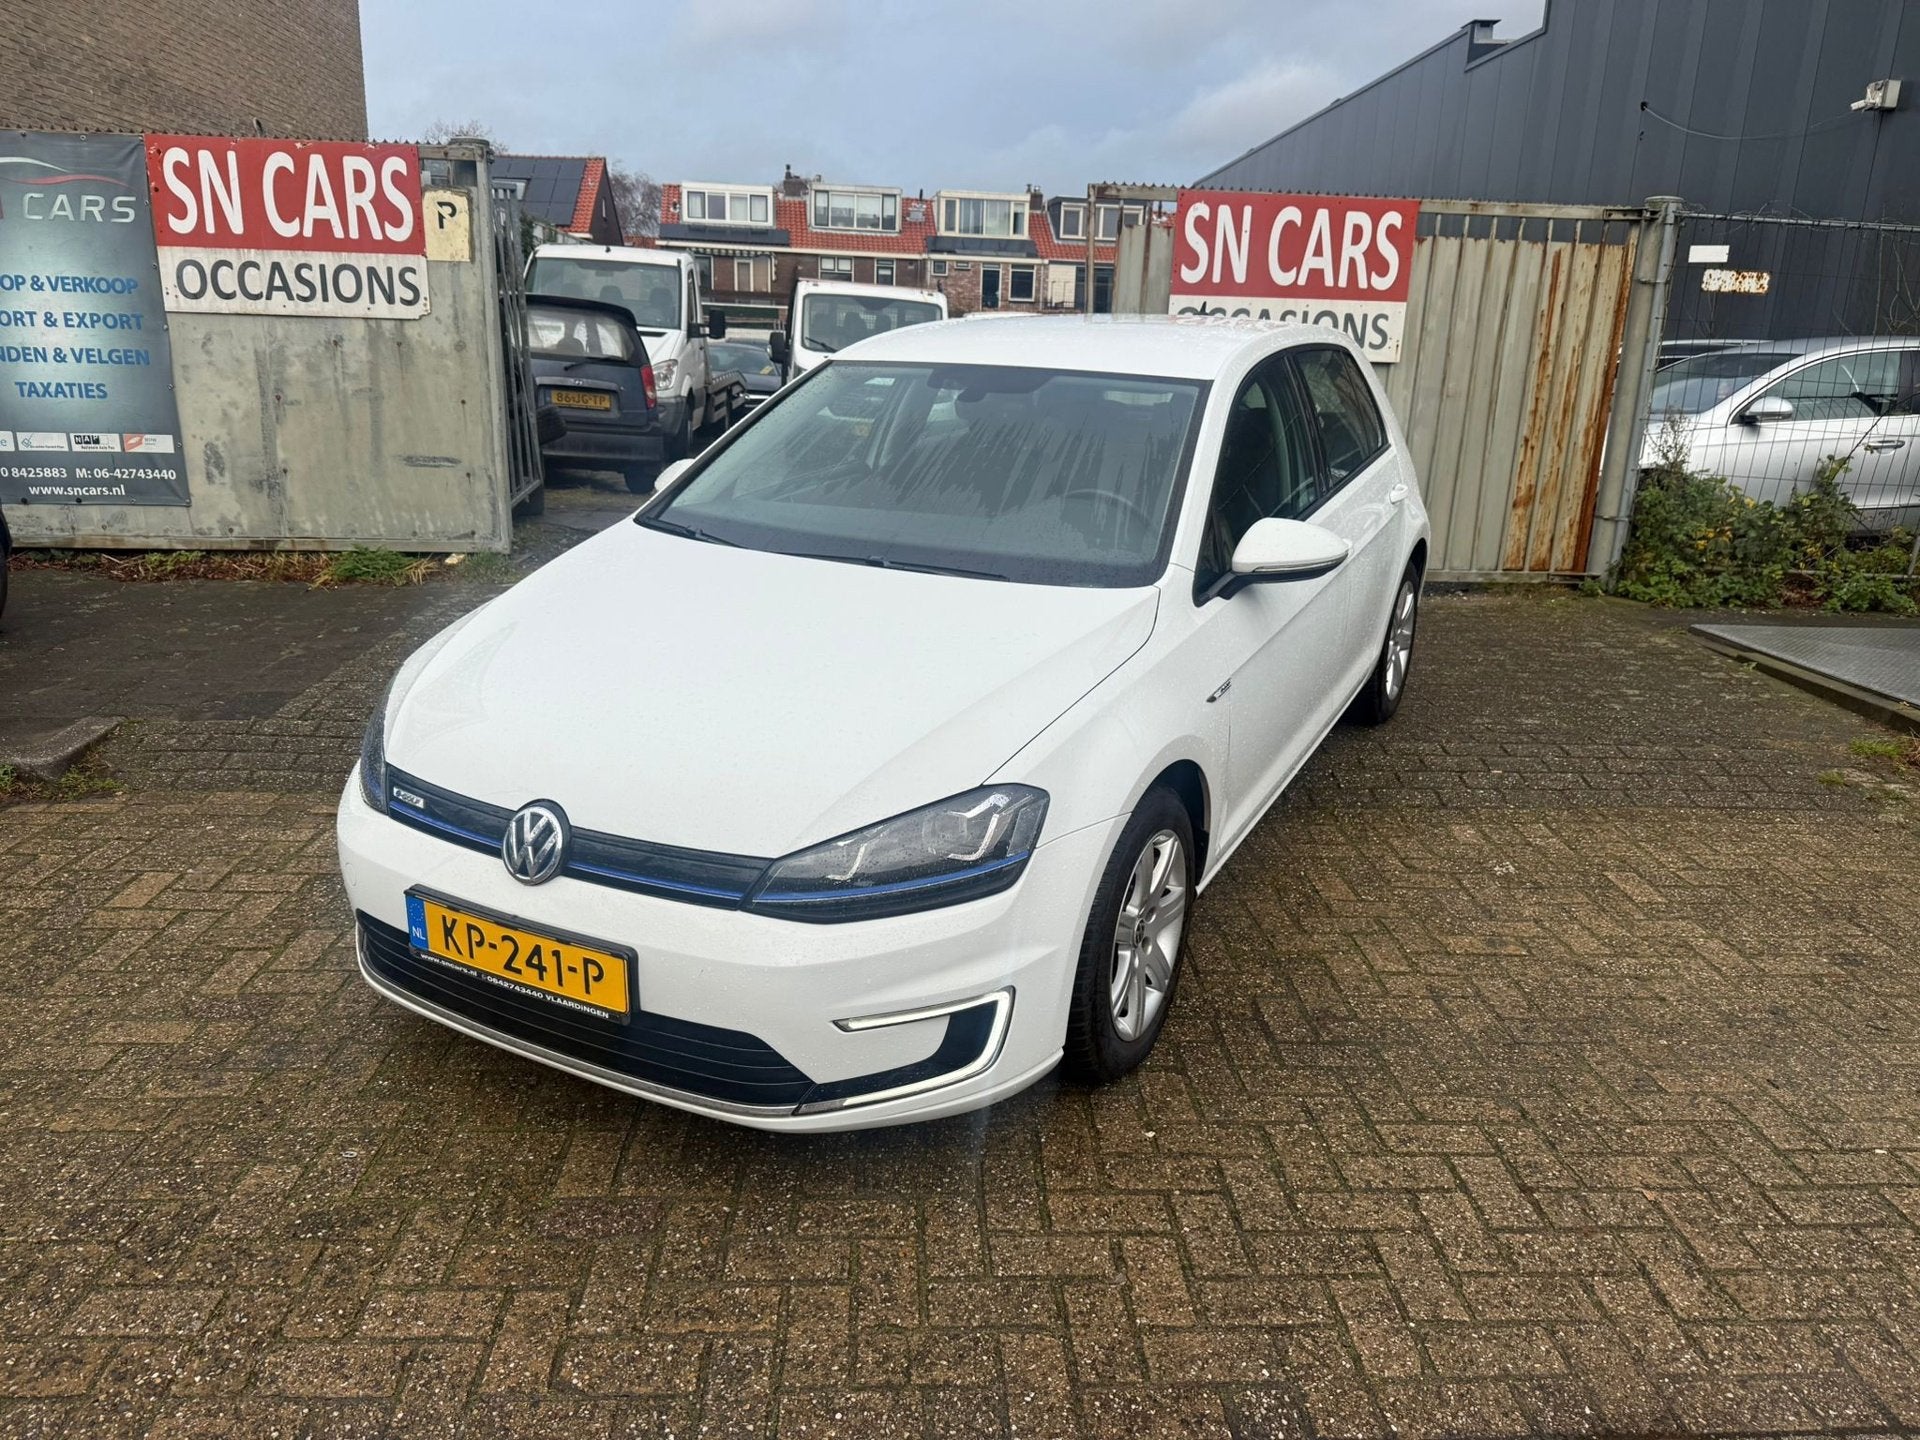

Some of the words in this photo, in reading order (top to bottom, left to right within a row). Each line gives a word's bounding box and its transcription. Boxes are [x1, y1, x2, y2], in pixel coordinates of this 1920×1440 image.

[161, 146, 245, 235] SN
[261, 151, 415, 242] CARS
[23, 192, 137, 223] CARS
[437, 201, 457, 229] P
[1180, 202, 1252, 284] SN
[1267, 205, 1402, 291] CARS
[30, 275, 45, 292] &
[46, 275, 139, 295] VERKOOP
[175, 258, 421, 307] OCCASIONS
[43, 311, 58, 327] &
[63, 312, 144, 330] EXPORT
[53, 347, 68, 363] &
[70, 347, 150, 366] VELGEN
[14, 381, 108, 399] TAXATIES
[11, 467, 67, 478] 8425883
[75, 468, 92, 478] M:
[94, 468, 177, 480] 06-42743440
[28, 484, 126, 496] www.sncars.nl
[411, 925, 426, 940] NL
[441, 914, 605, 995] KP-241-P
